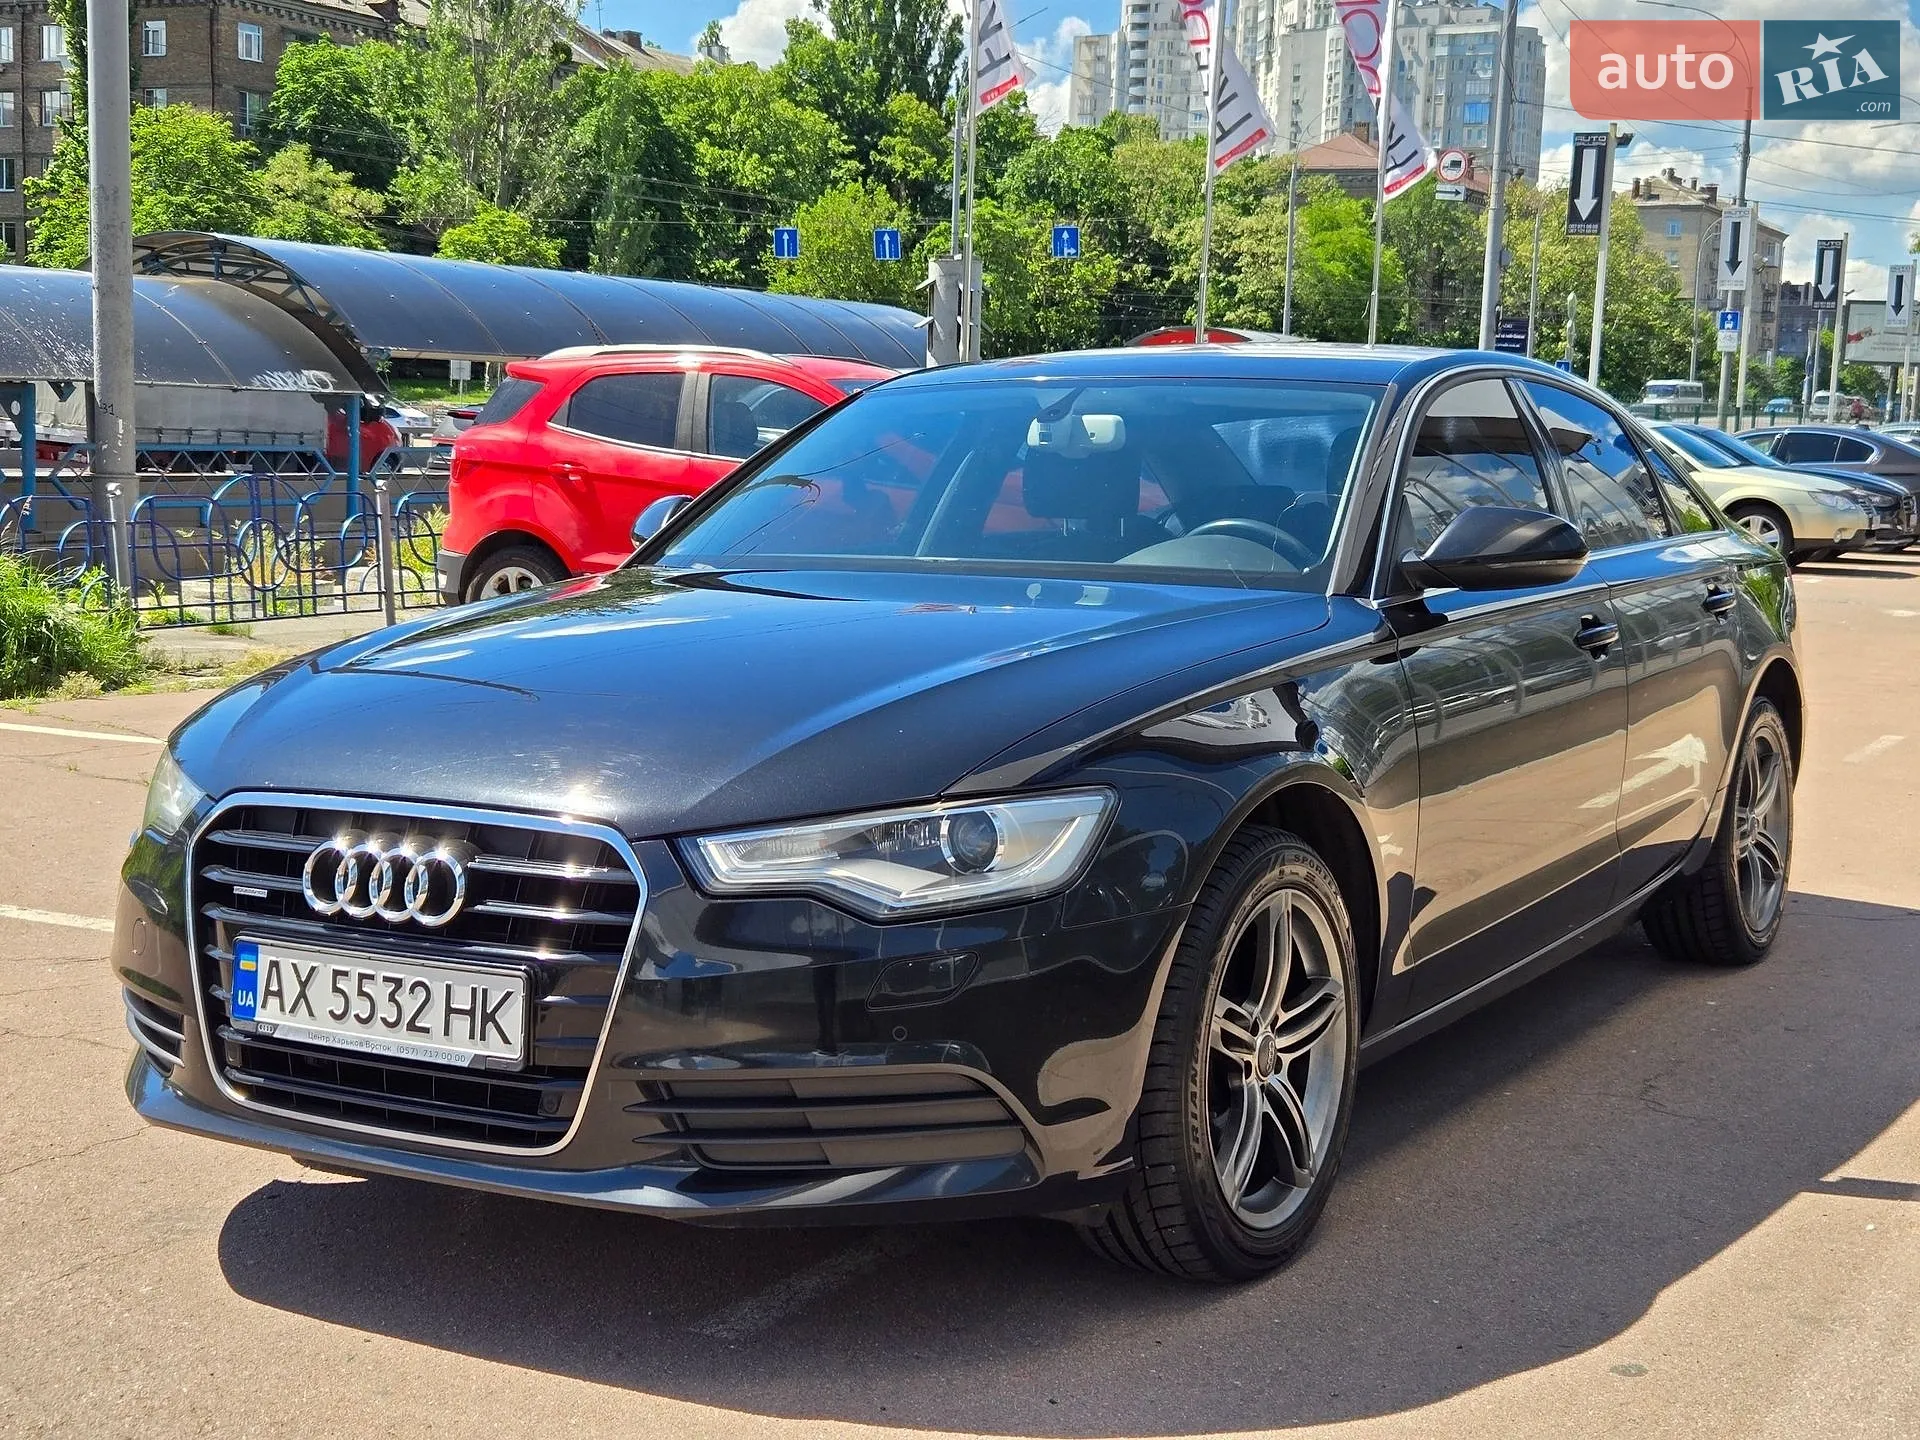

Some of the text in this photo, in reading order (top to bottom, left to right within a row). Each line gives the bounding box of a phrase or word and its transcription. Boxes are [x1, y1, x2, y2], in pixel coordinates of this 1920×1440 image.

[237, 990, 255, 1008] UA
[260, 958, 515, 1046] AX 5532 HK
[307, 1031, 331, 1044] Центр
[331, 1035, 365, 1048] Харьков
[365, 1040, 392, 1052] Восток
[396, 1045, 419, 1056] (057)
